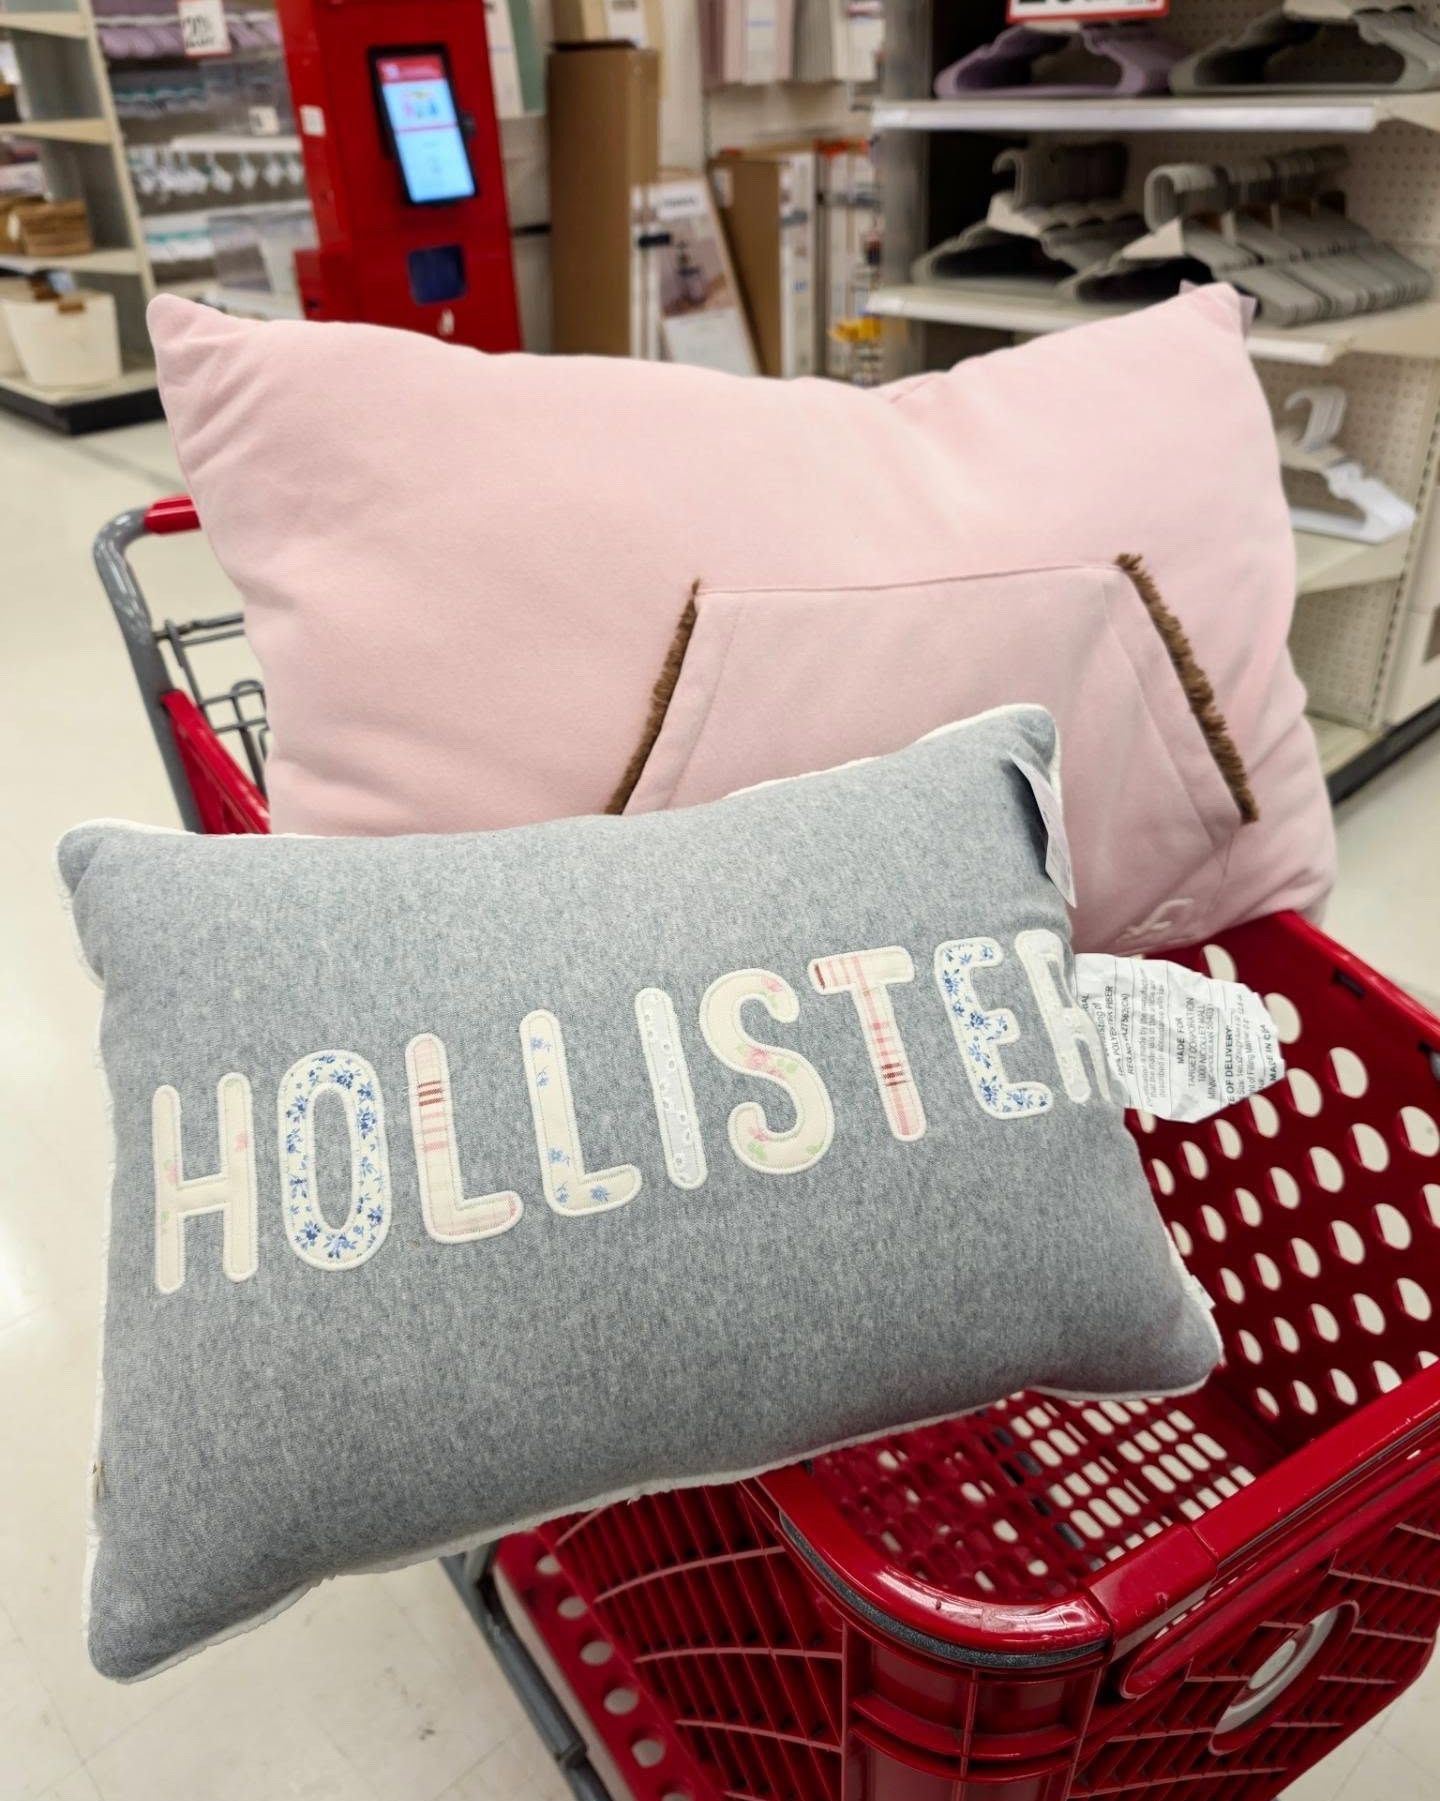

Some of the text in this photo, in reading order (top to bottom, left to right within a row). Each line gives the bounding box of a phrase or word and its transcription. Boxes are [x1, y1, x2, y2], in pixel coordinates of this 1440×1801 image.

[1105, 985, 1114, 1009] FIBER
[1176, 1037, 1184, 1064] MADE
[1265, 1042, 1272, 1052] IN
[1188, 1055, 1196, 1088] TARGET
[1226, 1080, 1234, 1094] OF
[152, 928, 1114, 1295] HOLLISTER
